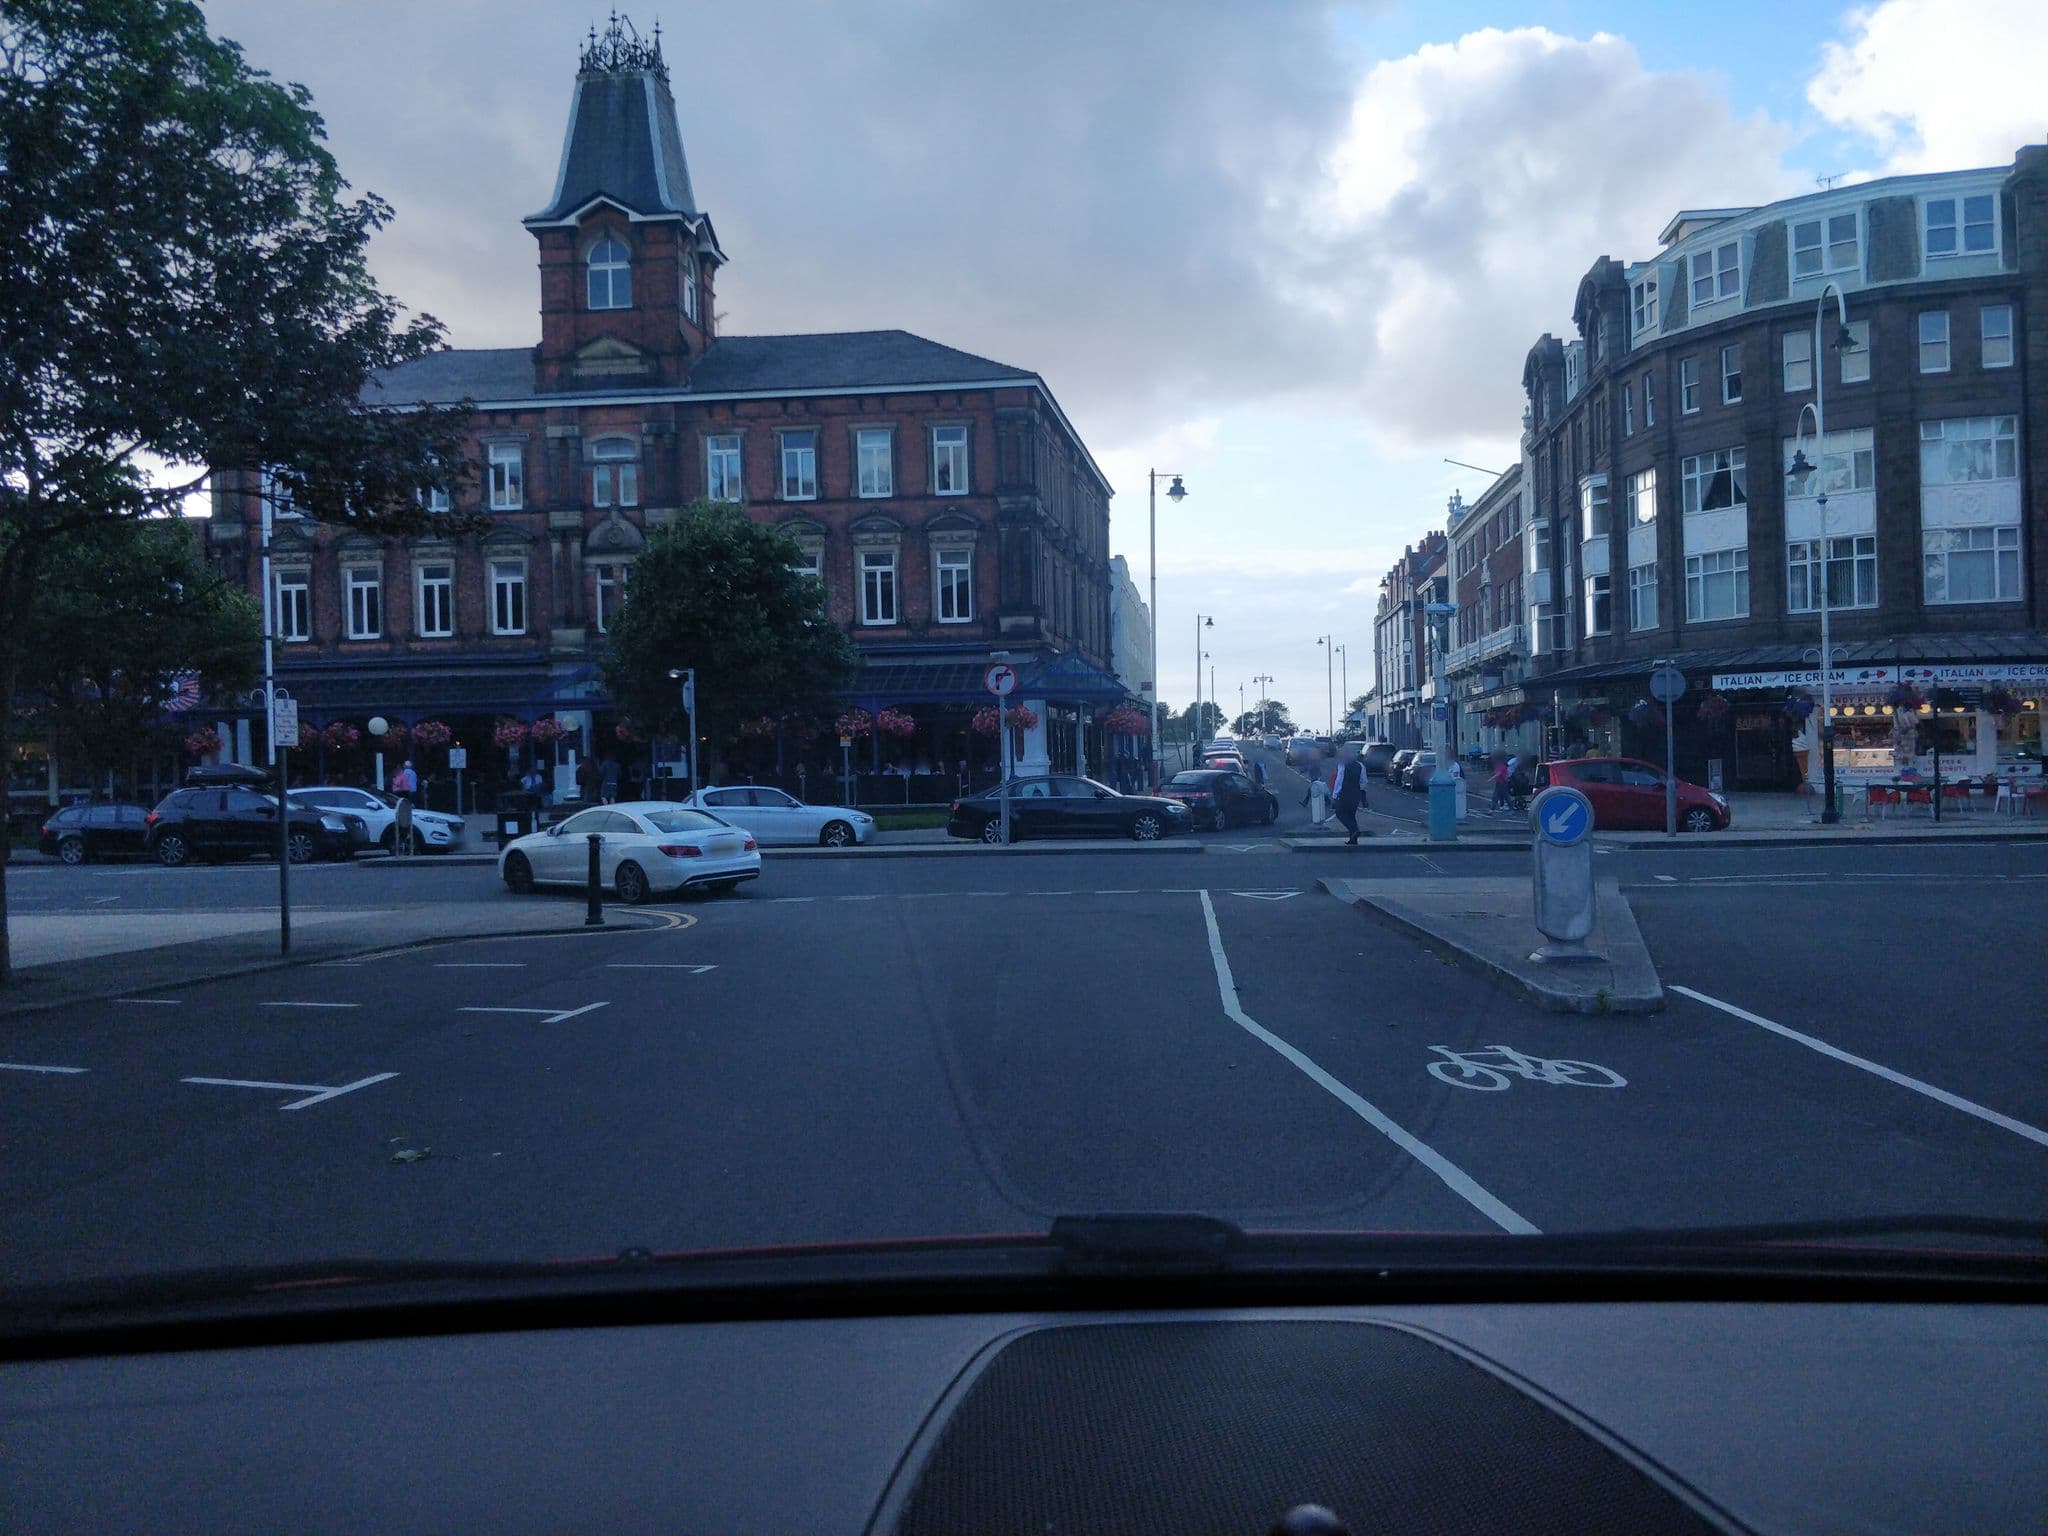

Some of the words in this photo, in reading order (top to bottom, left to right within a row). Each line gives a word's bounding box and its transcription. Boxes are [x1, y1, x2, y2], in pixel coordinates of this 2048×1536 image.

[1940, 667, 1984, 678] ITALIAN
[2007, 666, 2027, 676] ICE
[1720, 675, 1763, 686] ITALIAN
[1784, 673, 1803, 683] ICE
